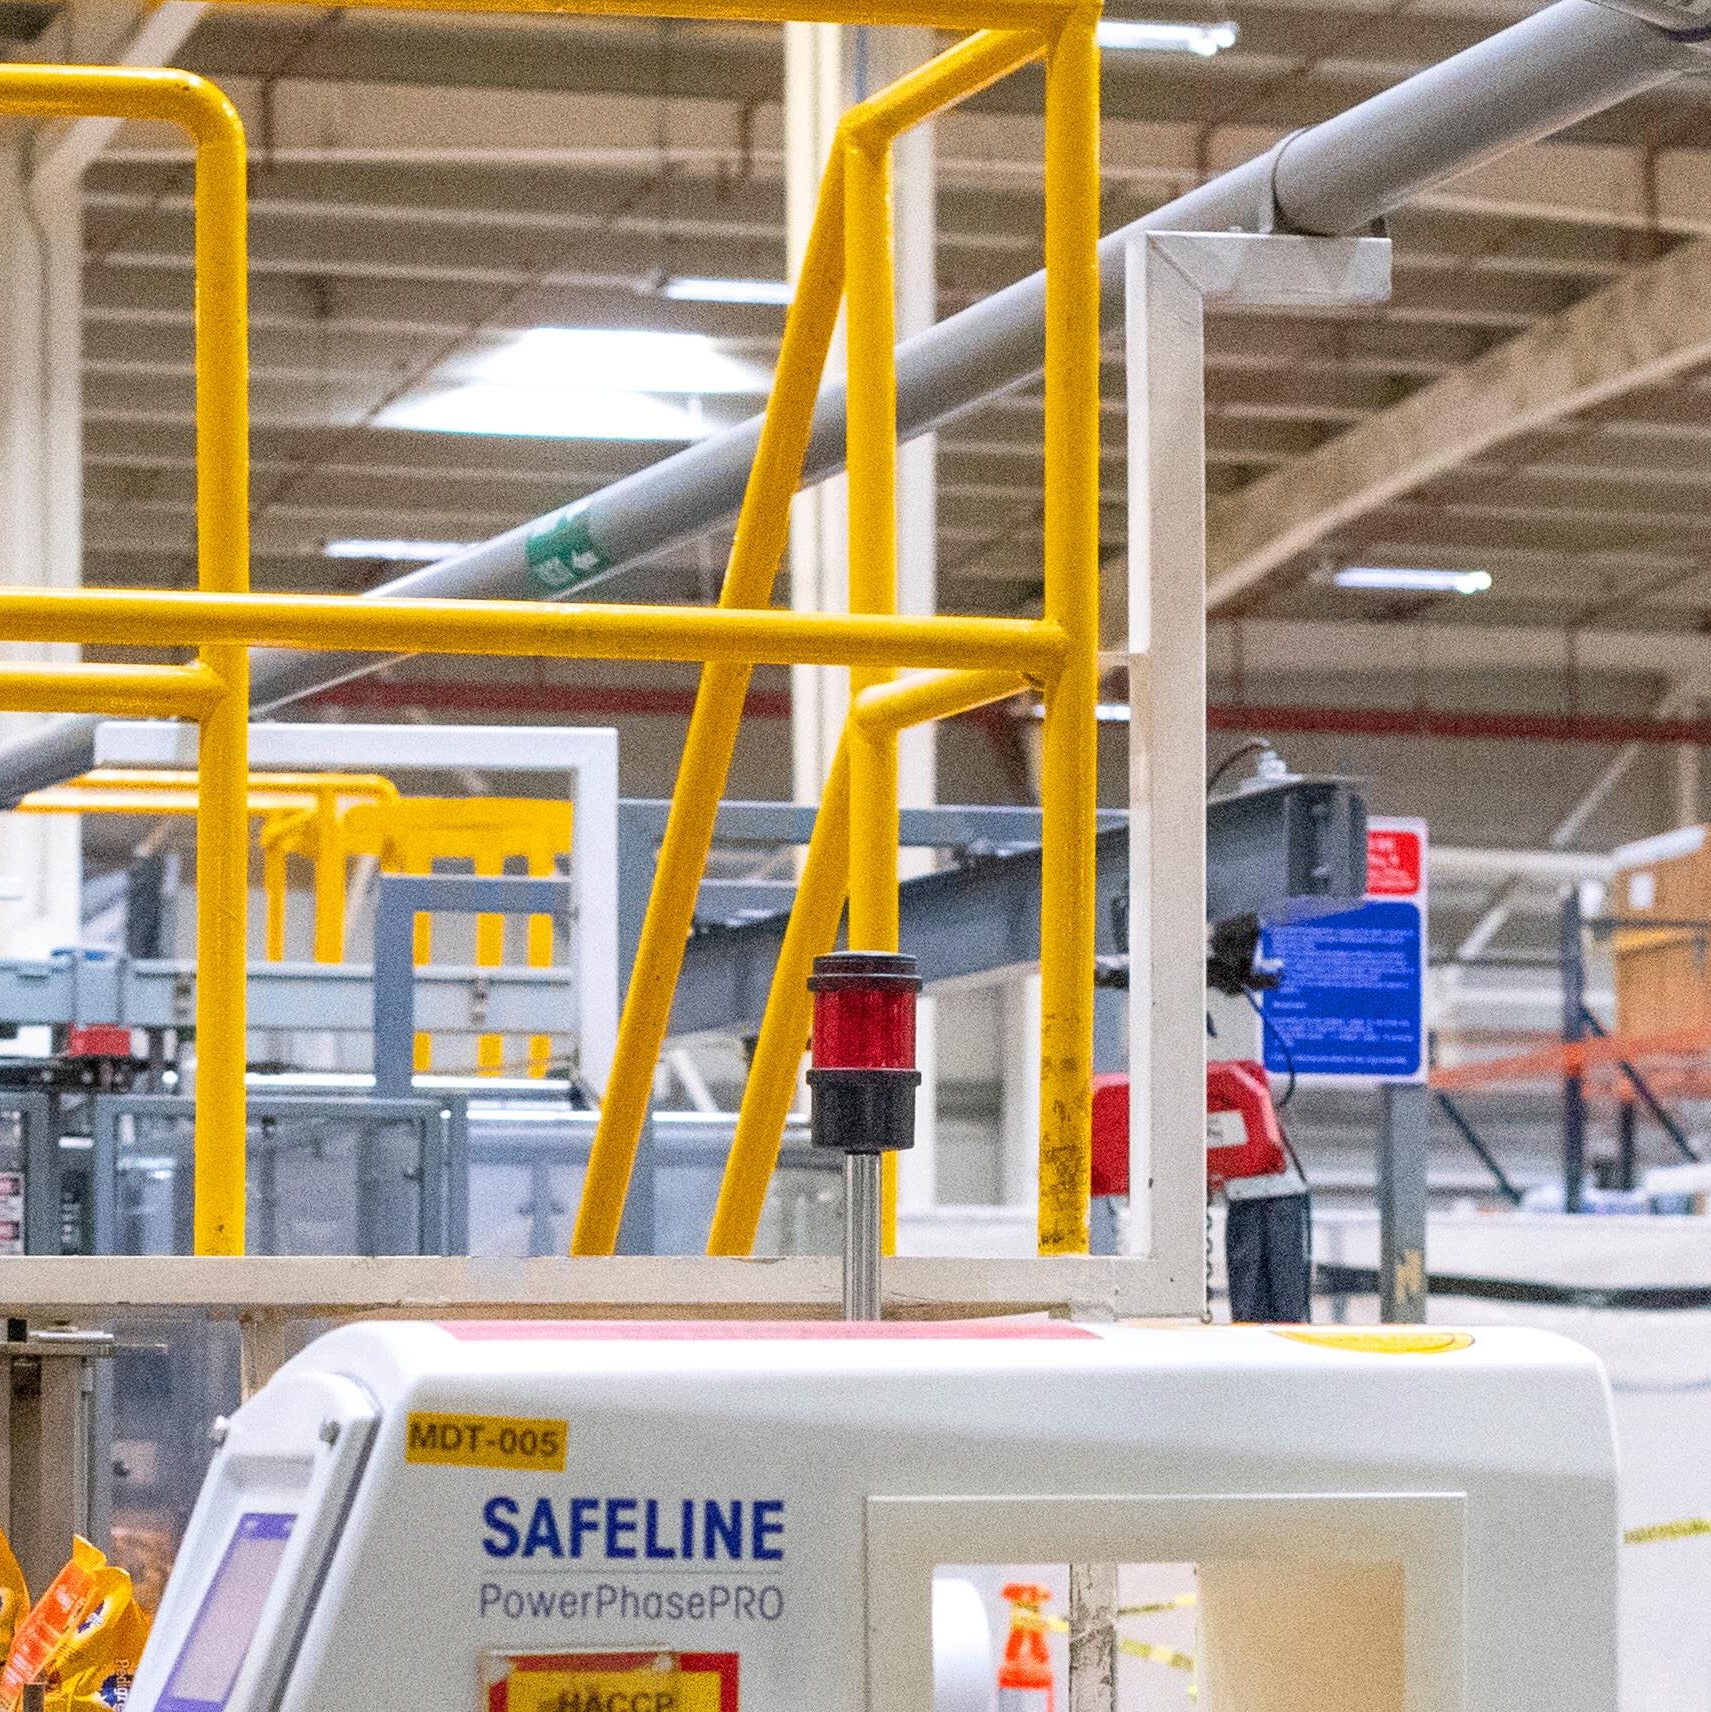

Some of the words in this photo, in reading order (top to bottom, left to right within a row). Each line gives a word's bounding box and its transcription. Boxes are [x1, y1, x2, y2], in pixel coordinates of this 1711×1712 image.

[410, 1421, 560, 1457] MDT-005
[482, 1496, 784, 1560] SAFELINE
[480, 1583, 784, 1621] PowerPhasePRO
